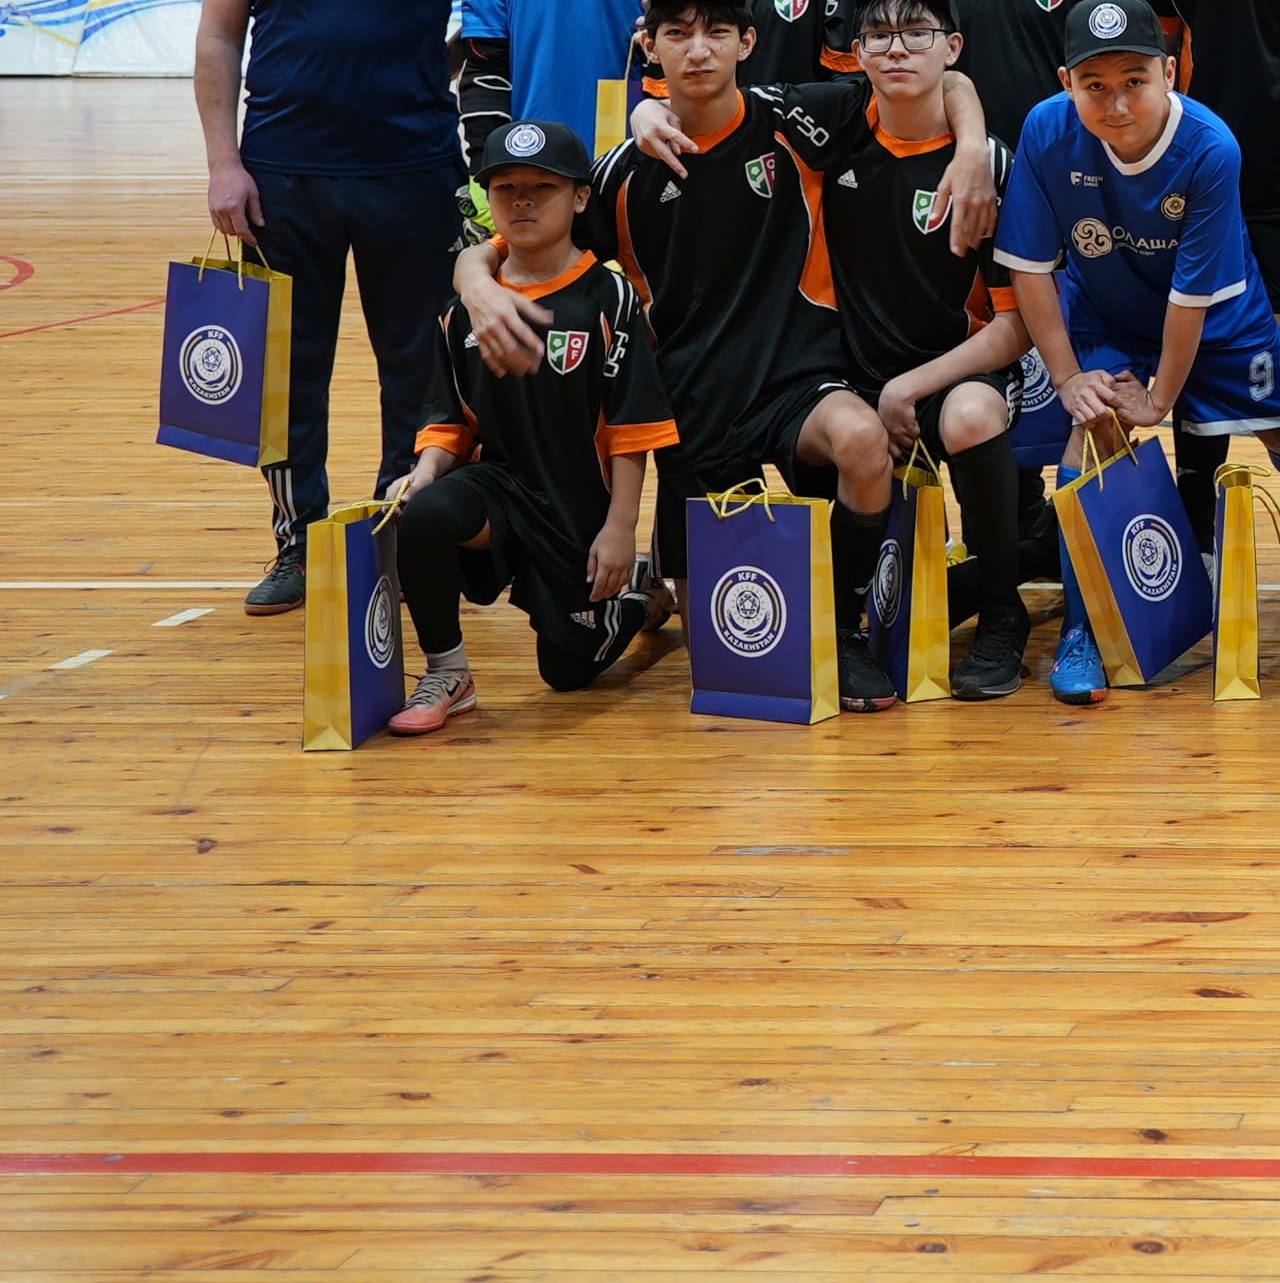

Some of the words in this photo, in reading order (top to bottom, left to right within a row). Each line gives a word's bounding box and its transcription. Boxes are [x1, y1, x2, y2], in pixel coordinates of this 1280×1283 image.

[1113, 226, 1178, 250] ОЛАША
[207, 330, 225, 342] KFF
[1248, 350, 1275, 403] 9
[1131, 521, 1145, 536] KFF
[737, 570, 759, 583] KFF
[1142, 563, 1178, 598] KAZAKHSTAN
[723, 628, 777, 651] KAZAKHSTAN
